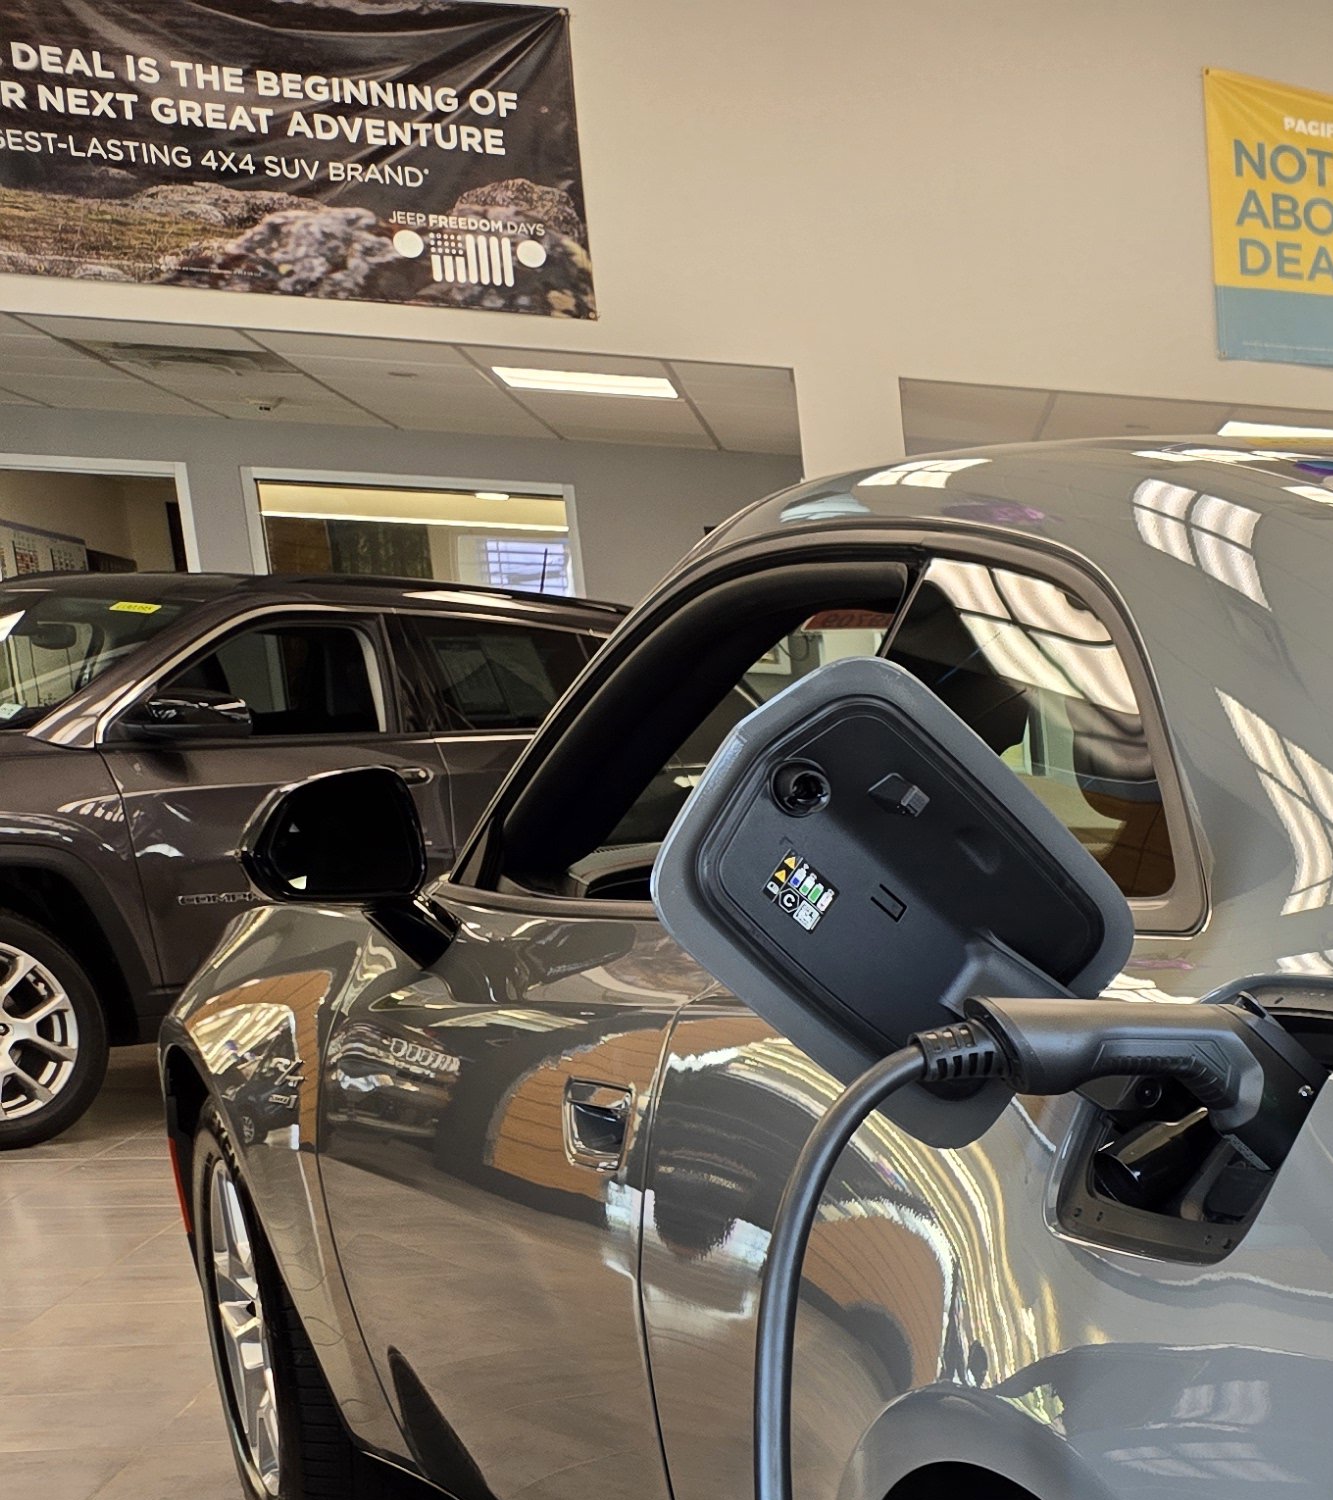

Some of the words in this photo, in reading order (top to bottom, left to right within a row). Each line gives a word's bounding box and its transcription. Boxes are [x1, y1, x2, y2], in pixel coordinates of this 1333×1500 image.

[10, 41, 116, 79] DEAL
[125, 54, 160, 83] IS
[170, 60, 245, 93] THE
[255, 70, 460, 113] BEGINNING
[468, 88, 519, 118] OF
[37, 84, 138, 120] NEXT
[150, 97, 274, 134] GREAT
[286, 111, 506, 156] ADVENTURE
[200, 149, 256, 175] 4X4
[264, 155, 320, 180] SUV
[388, 210, 427, 225] JEEP
[428, 214, 503, 233] FREEDOM
[507, 223, 546, 237] DAYS
